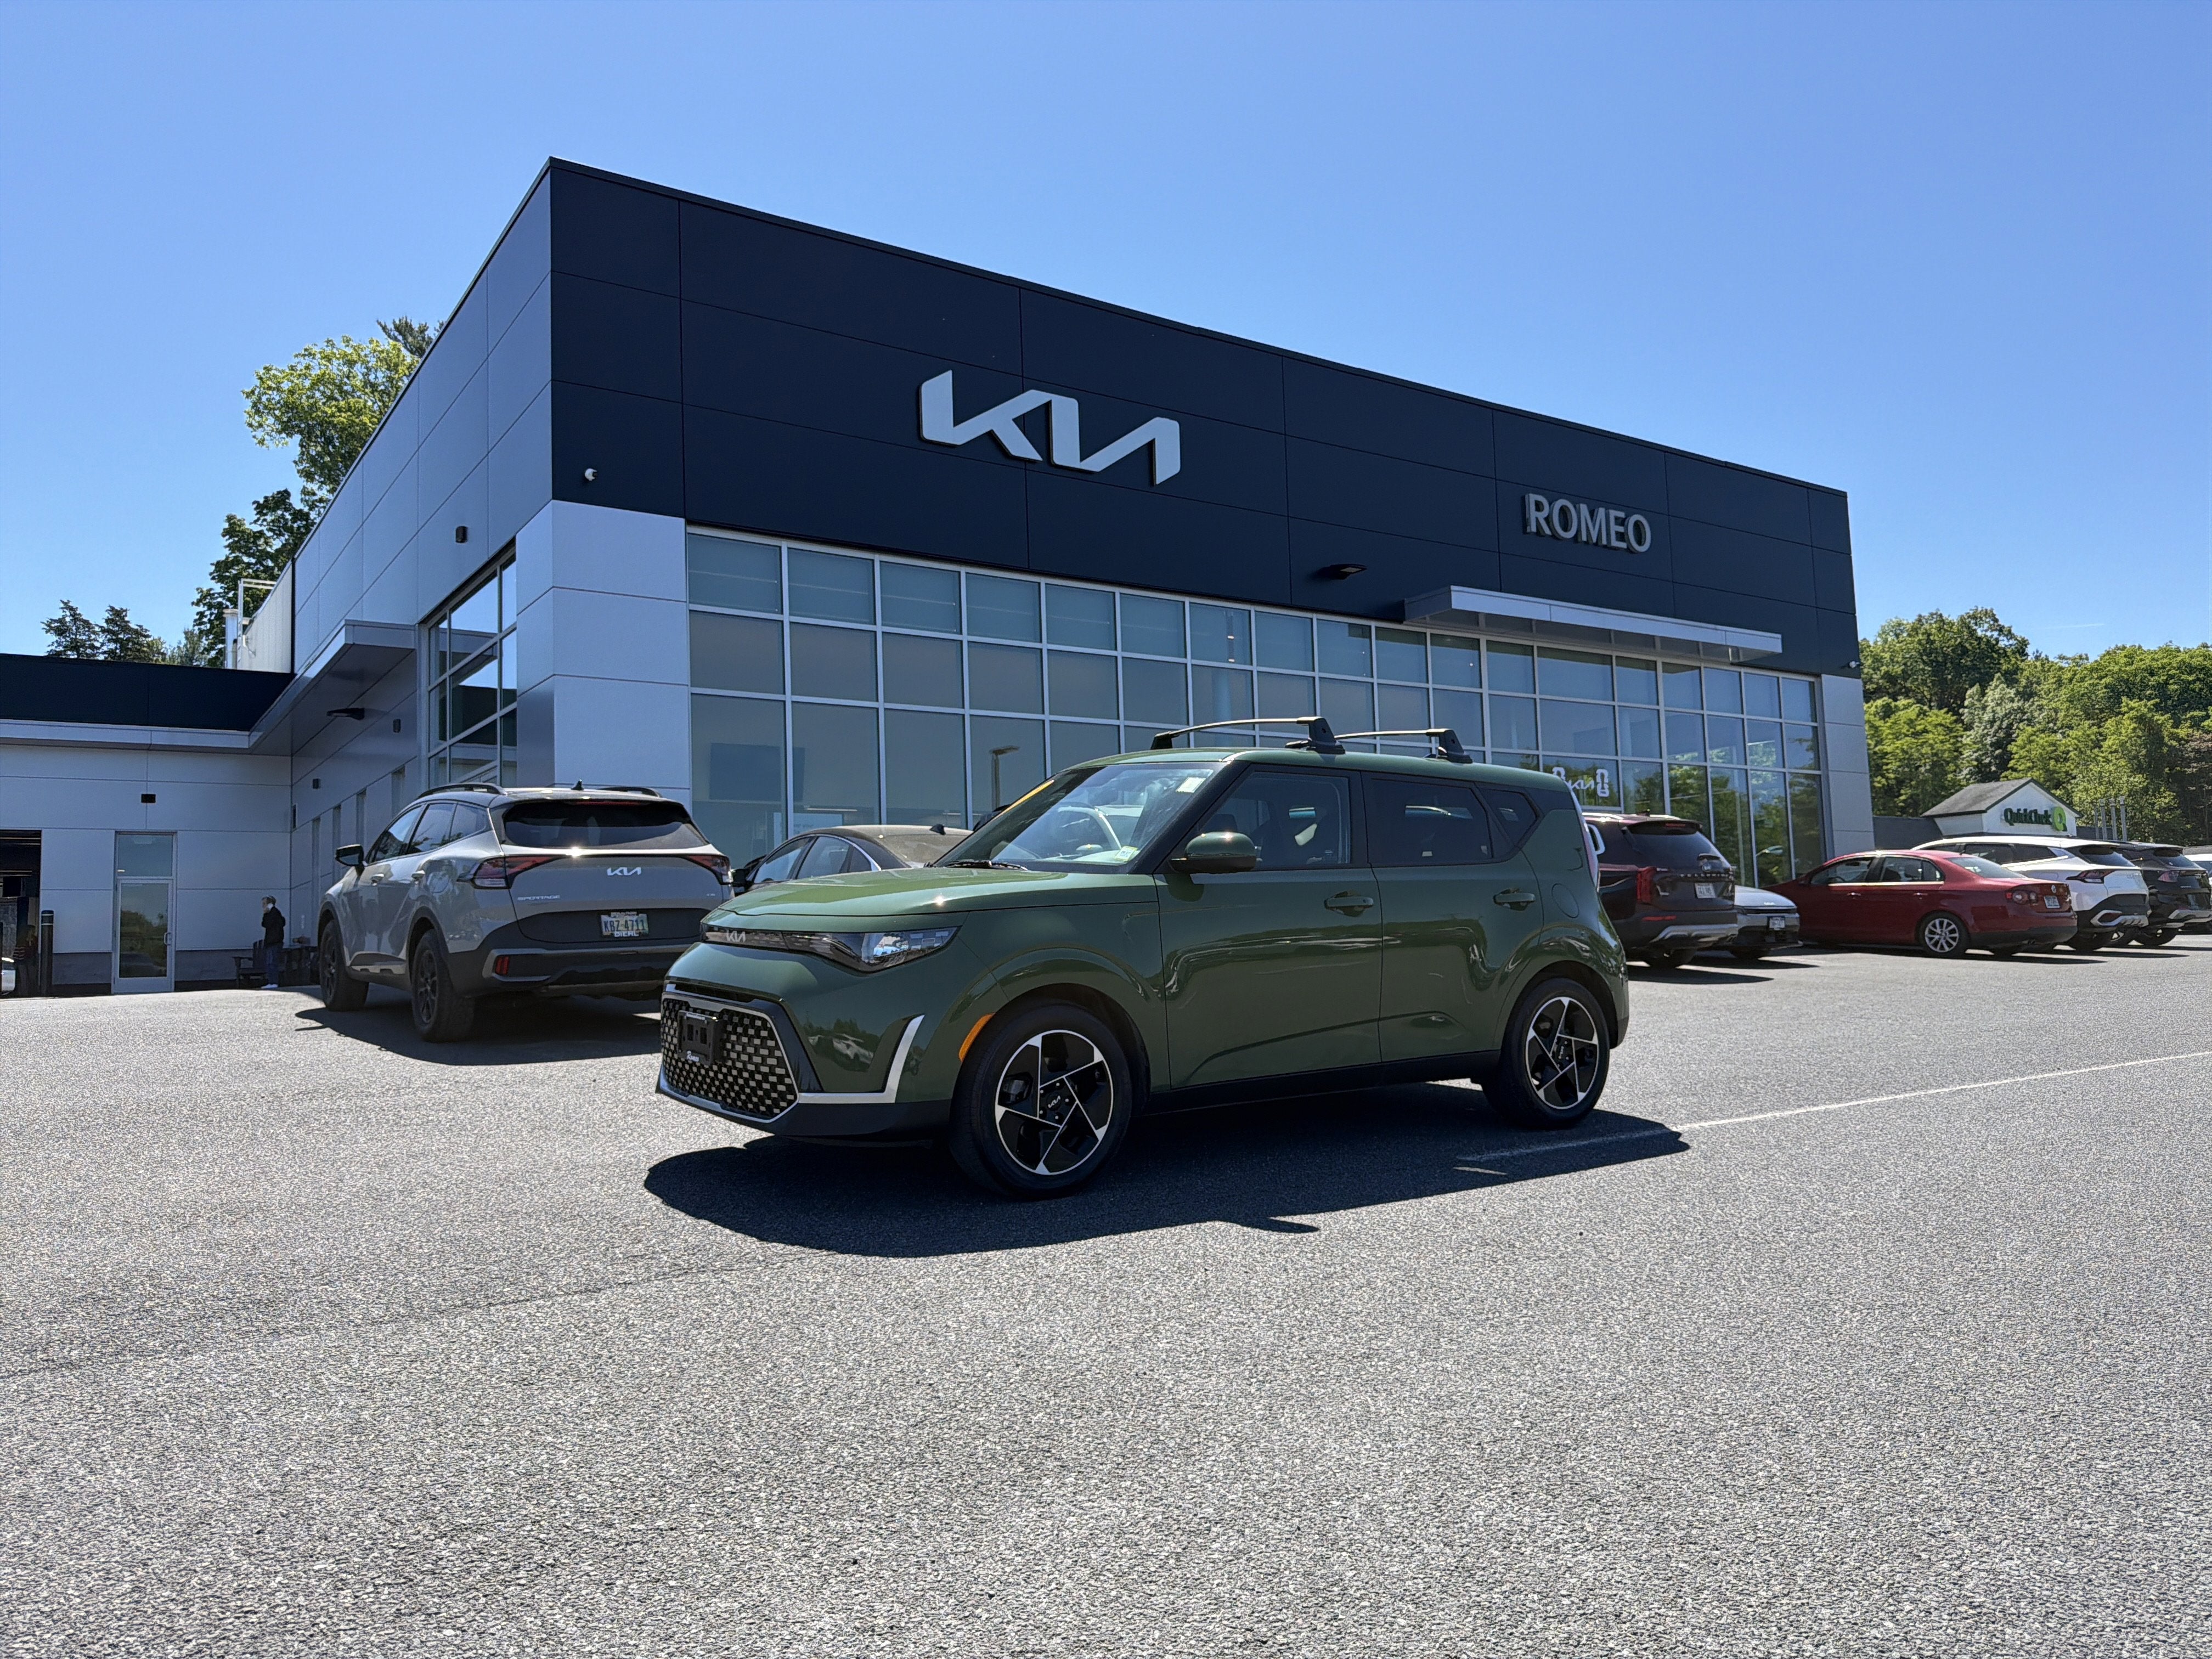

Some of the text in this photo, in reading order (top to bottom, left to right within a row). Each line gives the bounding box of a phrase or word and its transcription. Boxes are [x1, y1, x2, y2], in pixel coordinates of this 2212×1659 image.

[919, 369, 1181, 485] KIA
[1525, 493, 1652, 553] ROMEO
[607, 867, 641, 876] KIA
[726, 929, 746, 943] KIA
